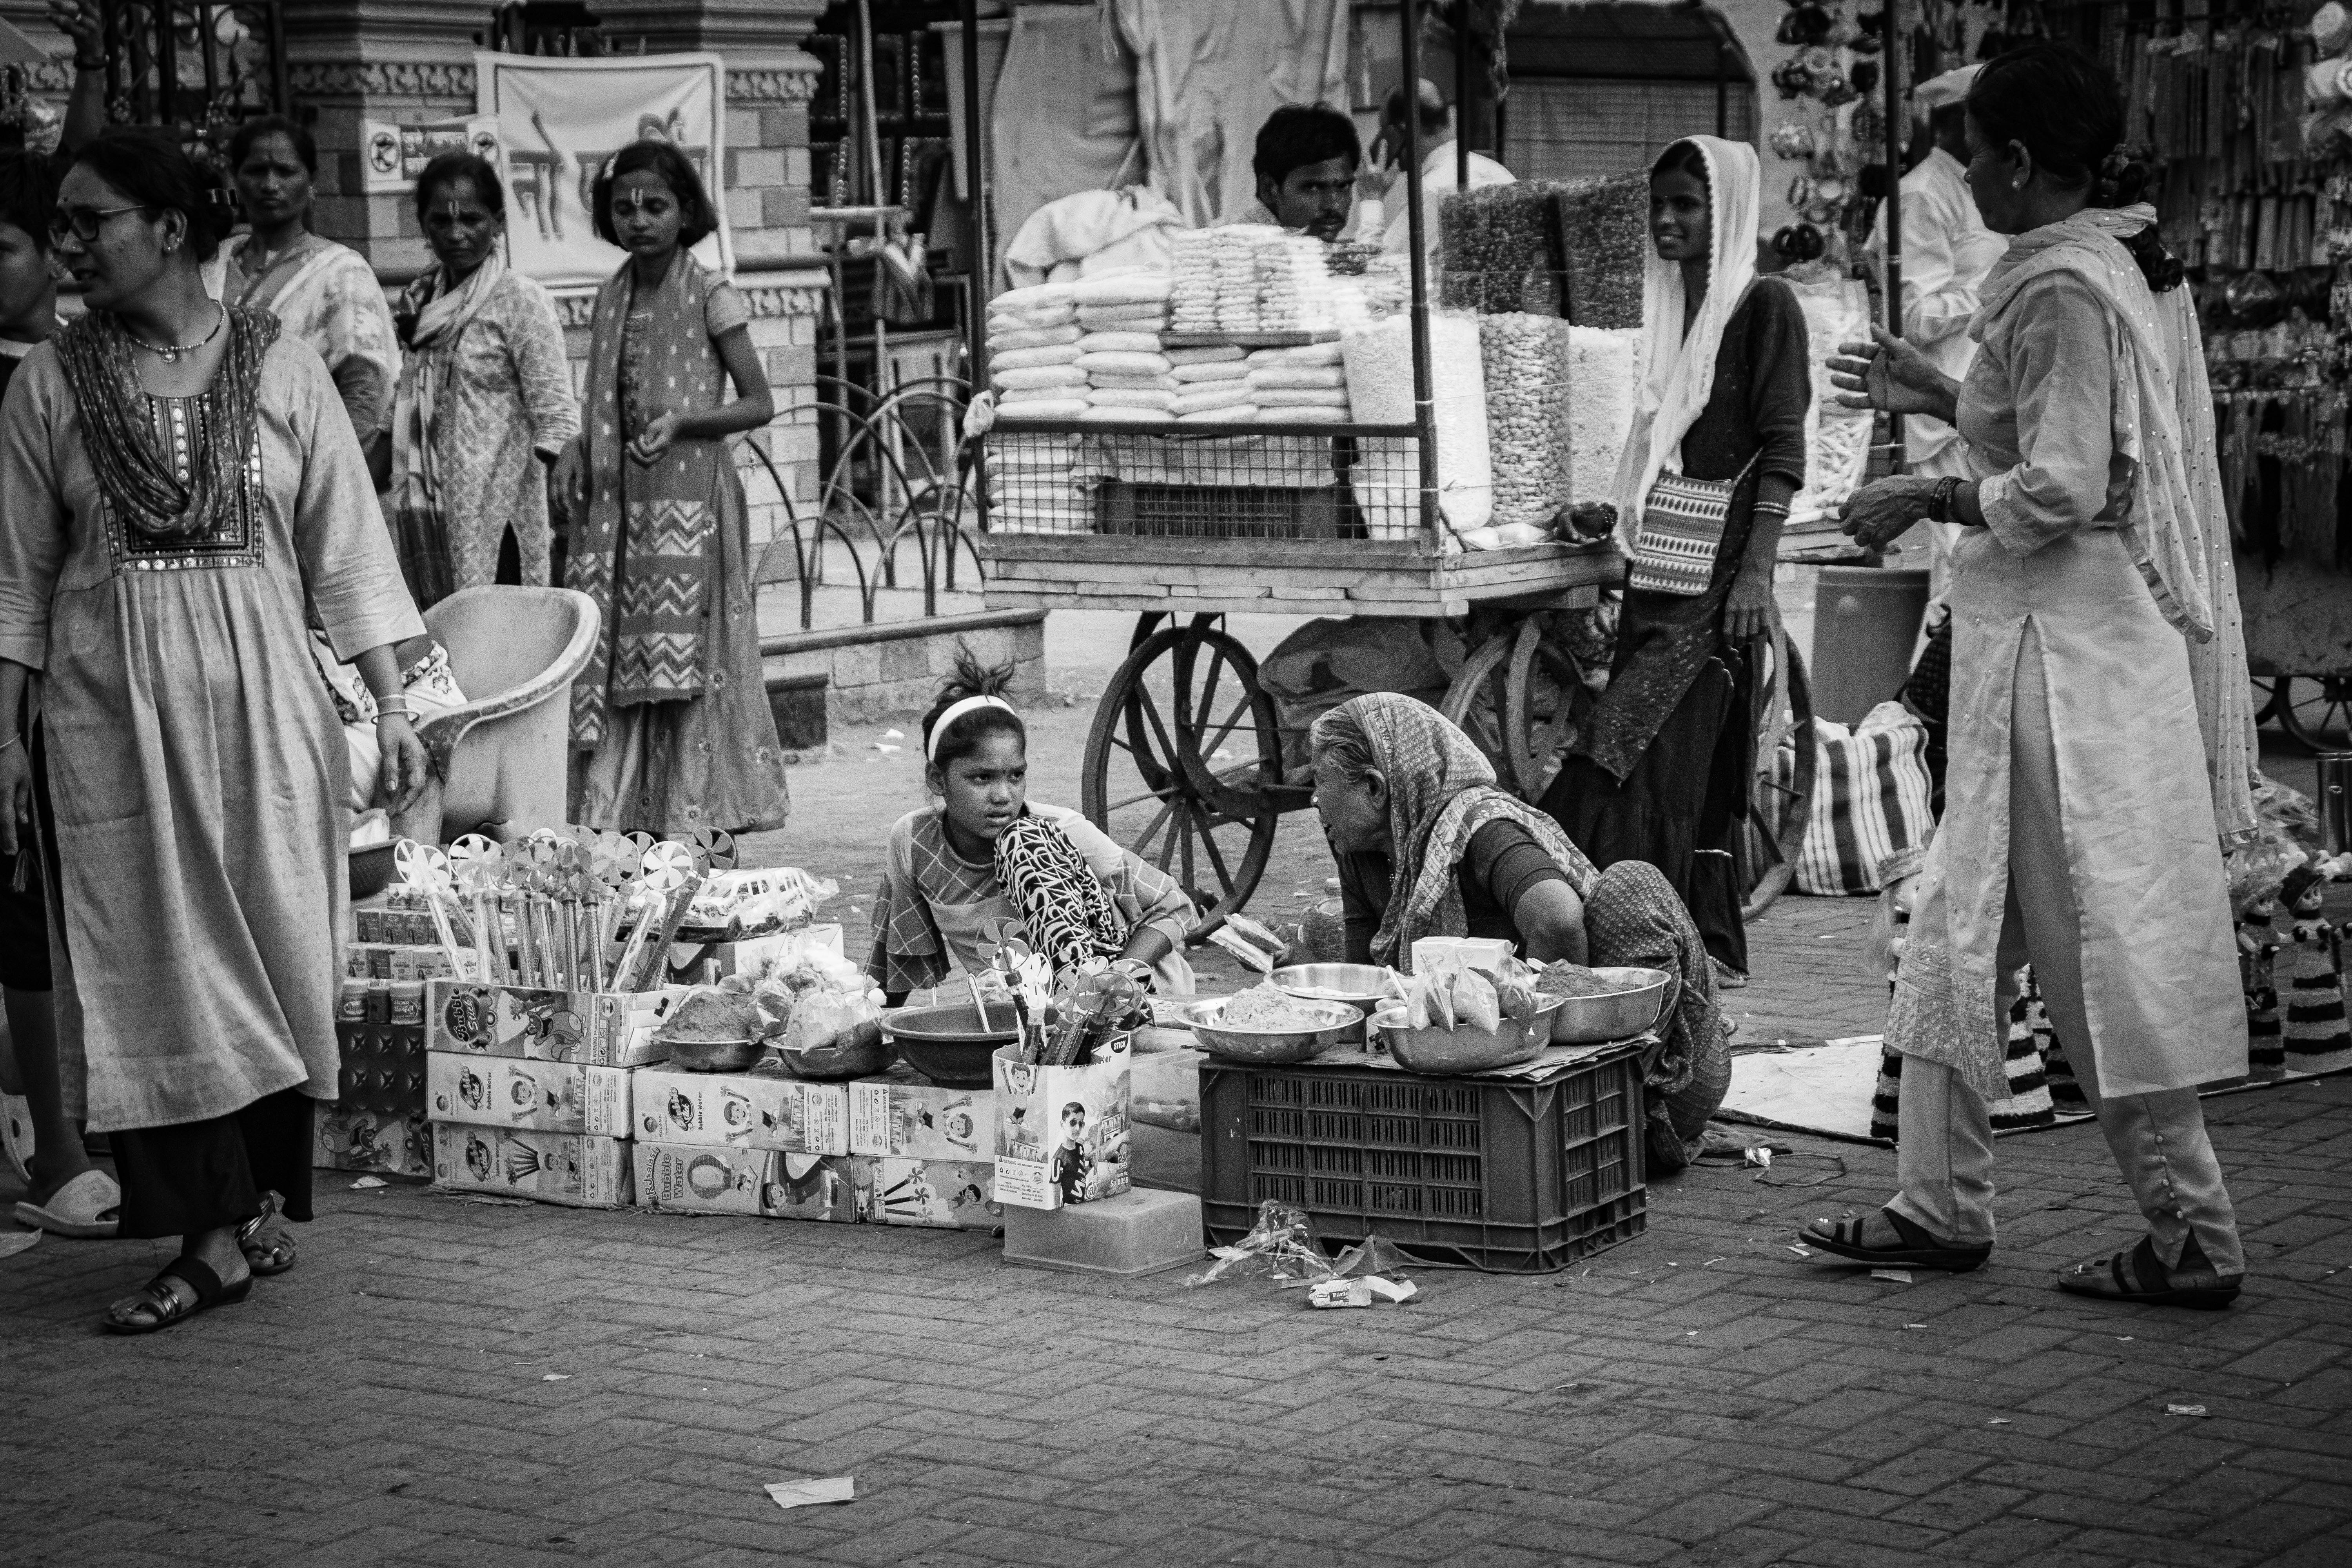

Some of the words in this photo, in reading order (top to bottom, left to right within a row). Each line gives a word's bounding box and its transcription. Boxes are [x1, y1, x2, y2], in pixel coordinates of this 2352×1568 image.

[452, 987, 470, 1042] Bubble
[463, 997, 478, 1031] Stick
[1113, 1039, 1126, 1050] STICK
[1118, 1152, 1127, 1163] 24
[661, 1153, 671, 1201] Bubble
[674, 1157, 683, 1198] Water
[1110, 1176, 1129, 1187] So-805B
